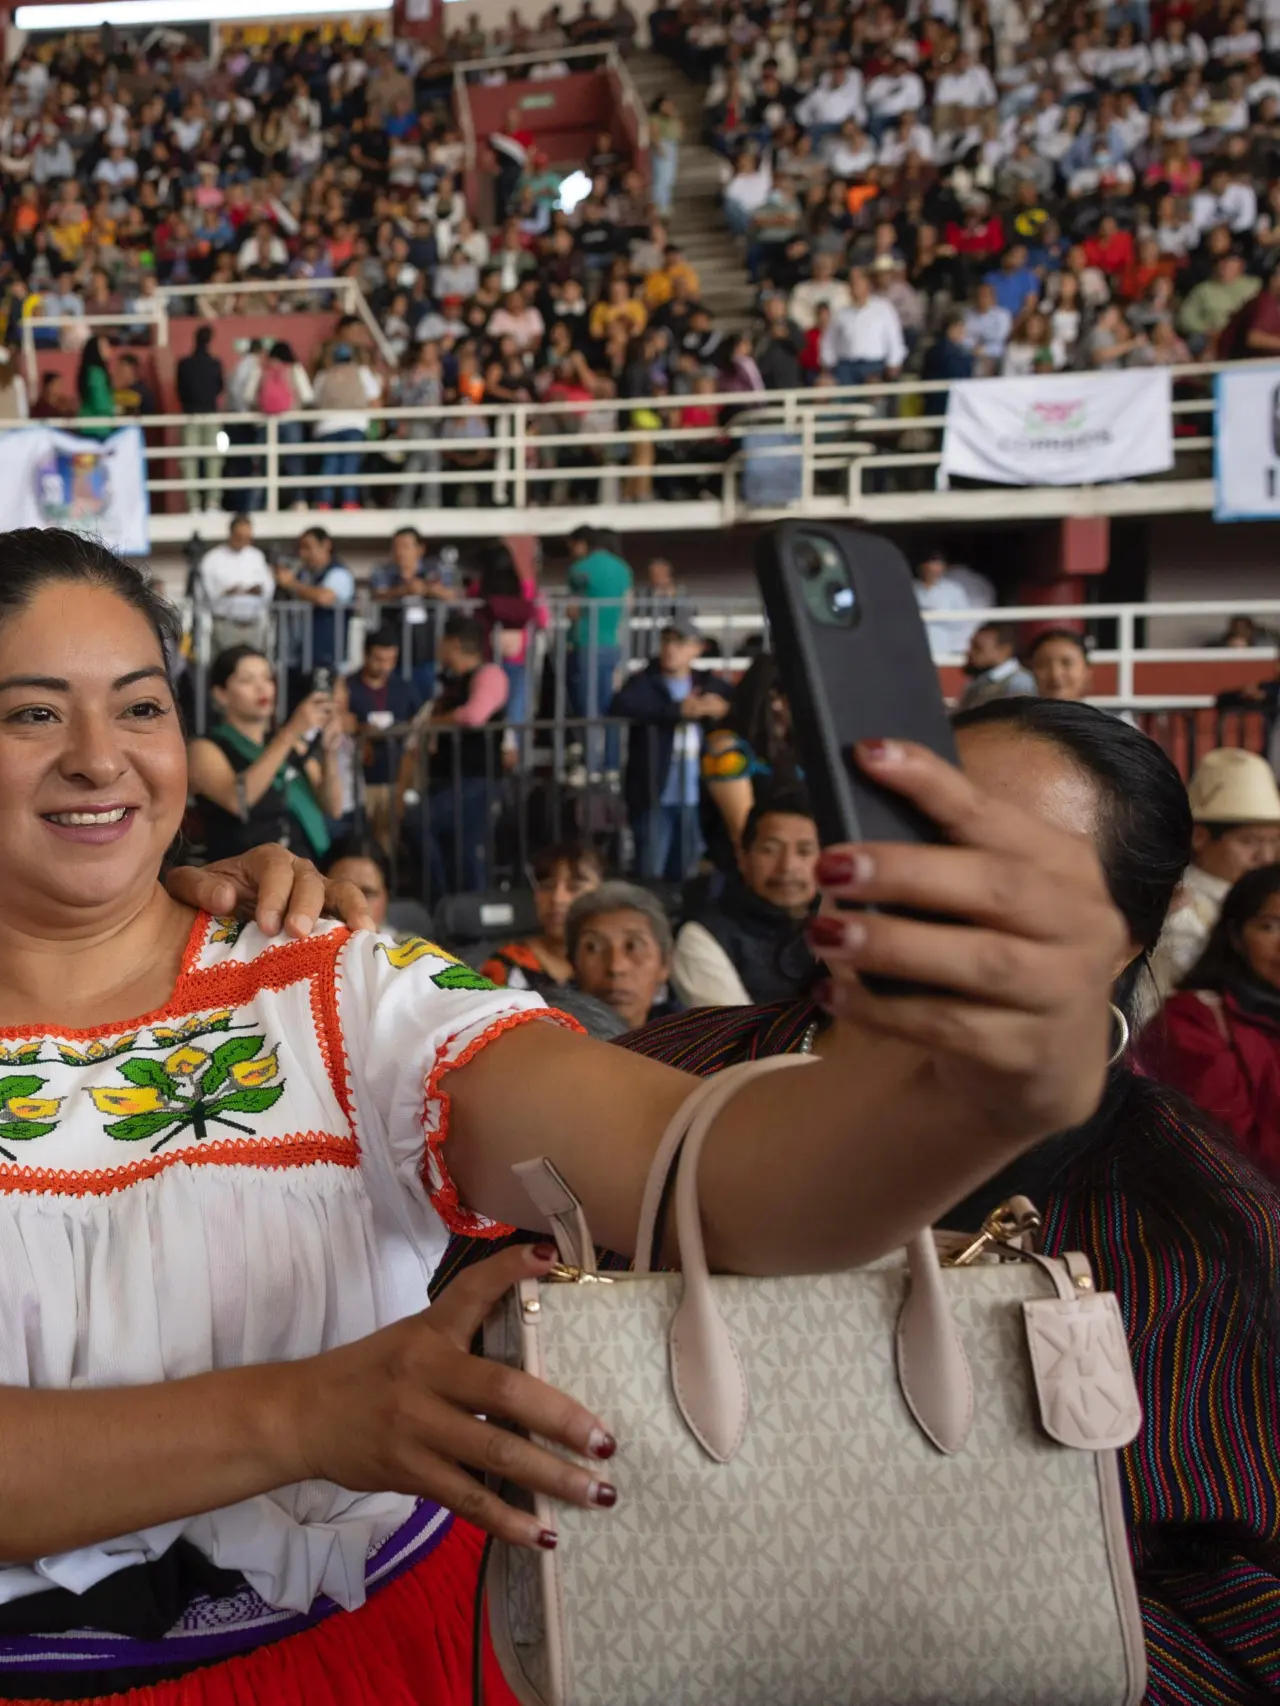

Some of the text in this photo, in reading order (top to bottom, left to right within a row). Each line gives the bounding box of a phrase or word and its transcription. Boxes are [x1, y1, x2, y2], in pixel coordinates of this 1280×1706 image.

[587, 1312, 640, 1342] MK
[747, 1304, 804, 1336] MK
[803, 1303, 861, 1334] MK
[558, 1335, 890, 1375] MK MK MK MK
[750, 1370, 810, 1401] MK
[807, 1368, 863, 1399] MK
[781, 1402, 839, 1433] MK
[837, 1401, 894, 1432] MK
[752, 1436, 810, 1467] MK
[810, 1435, 866, 1466] MK
[667, 1472, 725, 1504] MK
[726, 1471, 783, 1502] MK
[783, 1468, 839, 1500] MK
[839, 1466, 894, 1498] MK
[894, 1463, 952, 1495] MK
[950, 1461, 1008, 1493] MK
[637, 1503, 695, 1535] MK
[695, 1503, 754, 1535] MK
[754, 1502, 812, 1534] MK
[812, 1500, 868, 1532] MK
[868, 1499, 924, 1530] MK
[923, 1496, 980, 1528] MK
[980, 1493, 1033, 1525] MK
[606, 1535, 664, 1567] MK
[665, 1535, 723, 1567] MK
[724, 1535, 782, 1567] MK
[782, 1534, 840, 1566] MK
[840, 1533, 897, 1564] MK
[896, 1531, 954, 1562] MK
[952, 1529, 1009, 1560] MK
[1007, 1525, 1060, 1558] MK
[575, 1557, 1085, 1600] MK MK MK MK MK MK MK MK MK
[603, 1599, 662, 1632] MK
[662, 1600, 721, 1632] MK
[721, 1600, 780, 1632] MK
[780, 1600, 837, 1631] MK
[837, 1600, 895, 1631] MK
[894, 1598, 954, 1629] MK
[953, 1597, 1008, 1627] MK
[1007, 1592, 1062, 1625] MK
[573, 1630, 631, 1662] MK
[631, 1632, 690, 1663] MK
[690, 1632, 747, 1662] MK
[747, 1632, 804, 1662] MK
[804, 1631, 863, 1661] MK
[979, 1627, 1034, 1659] MK
